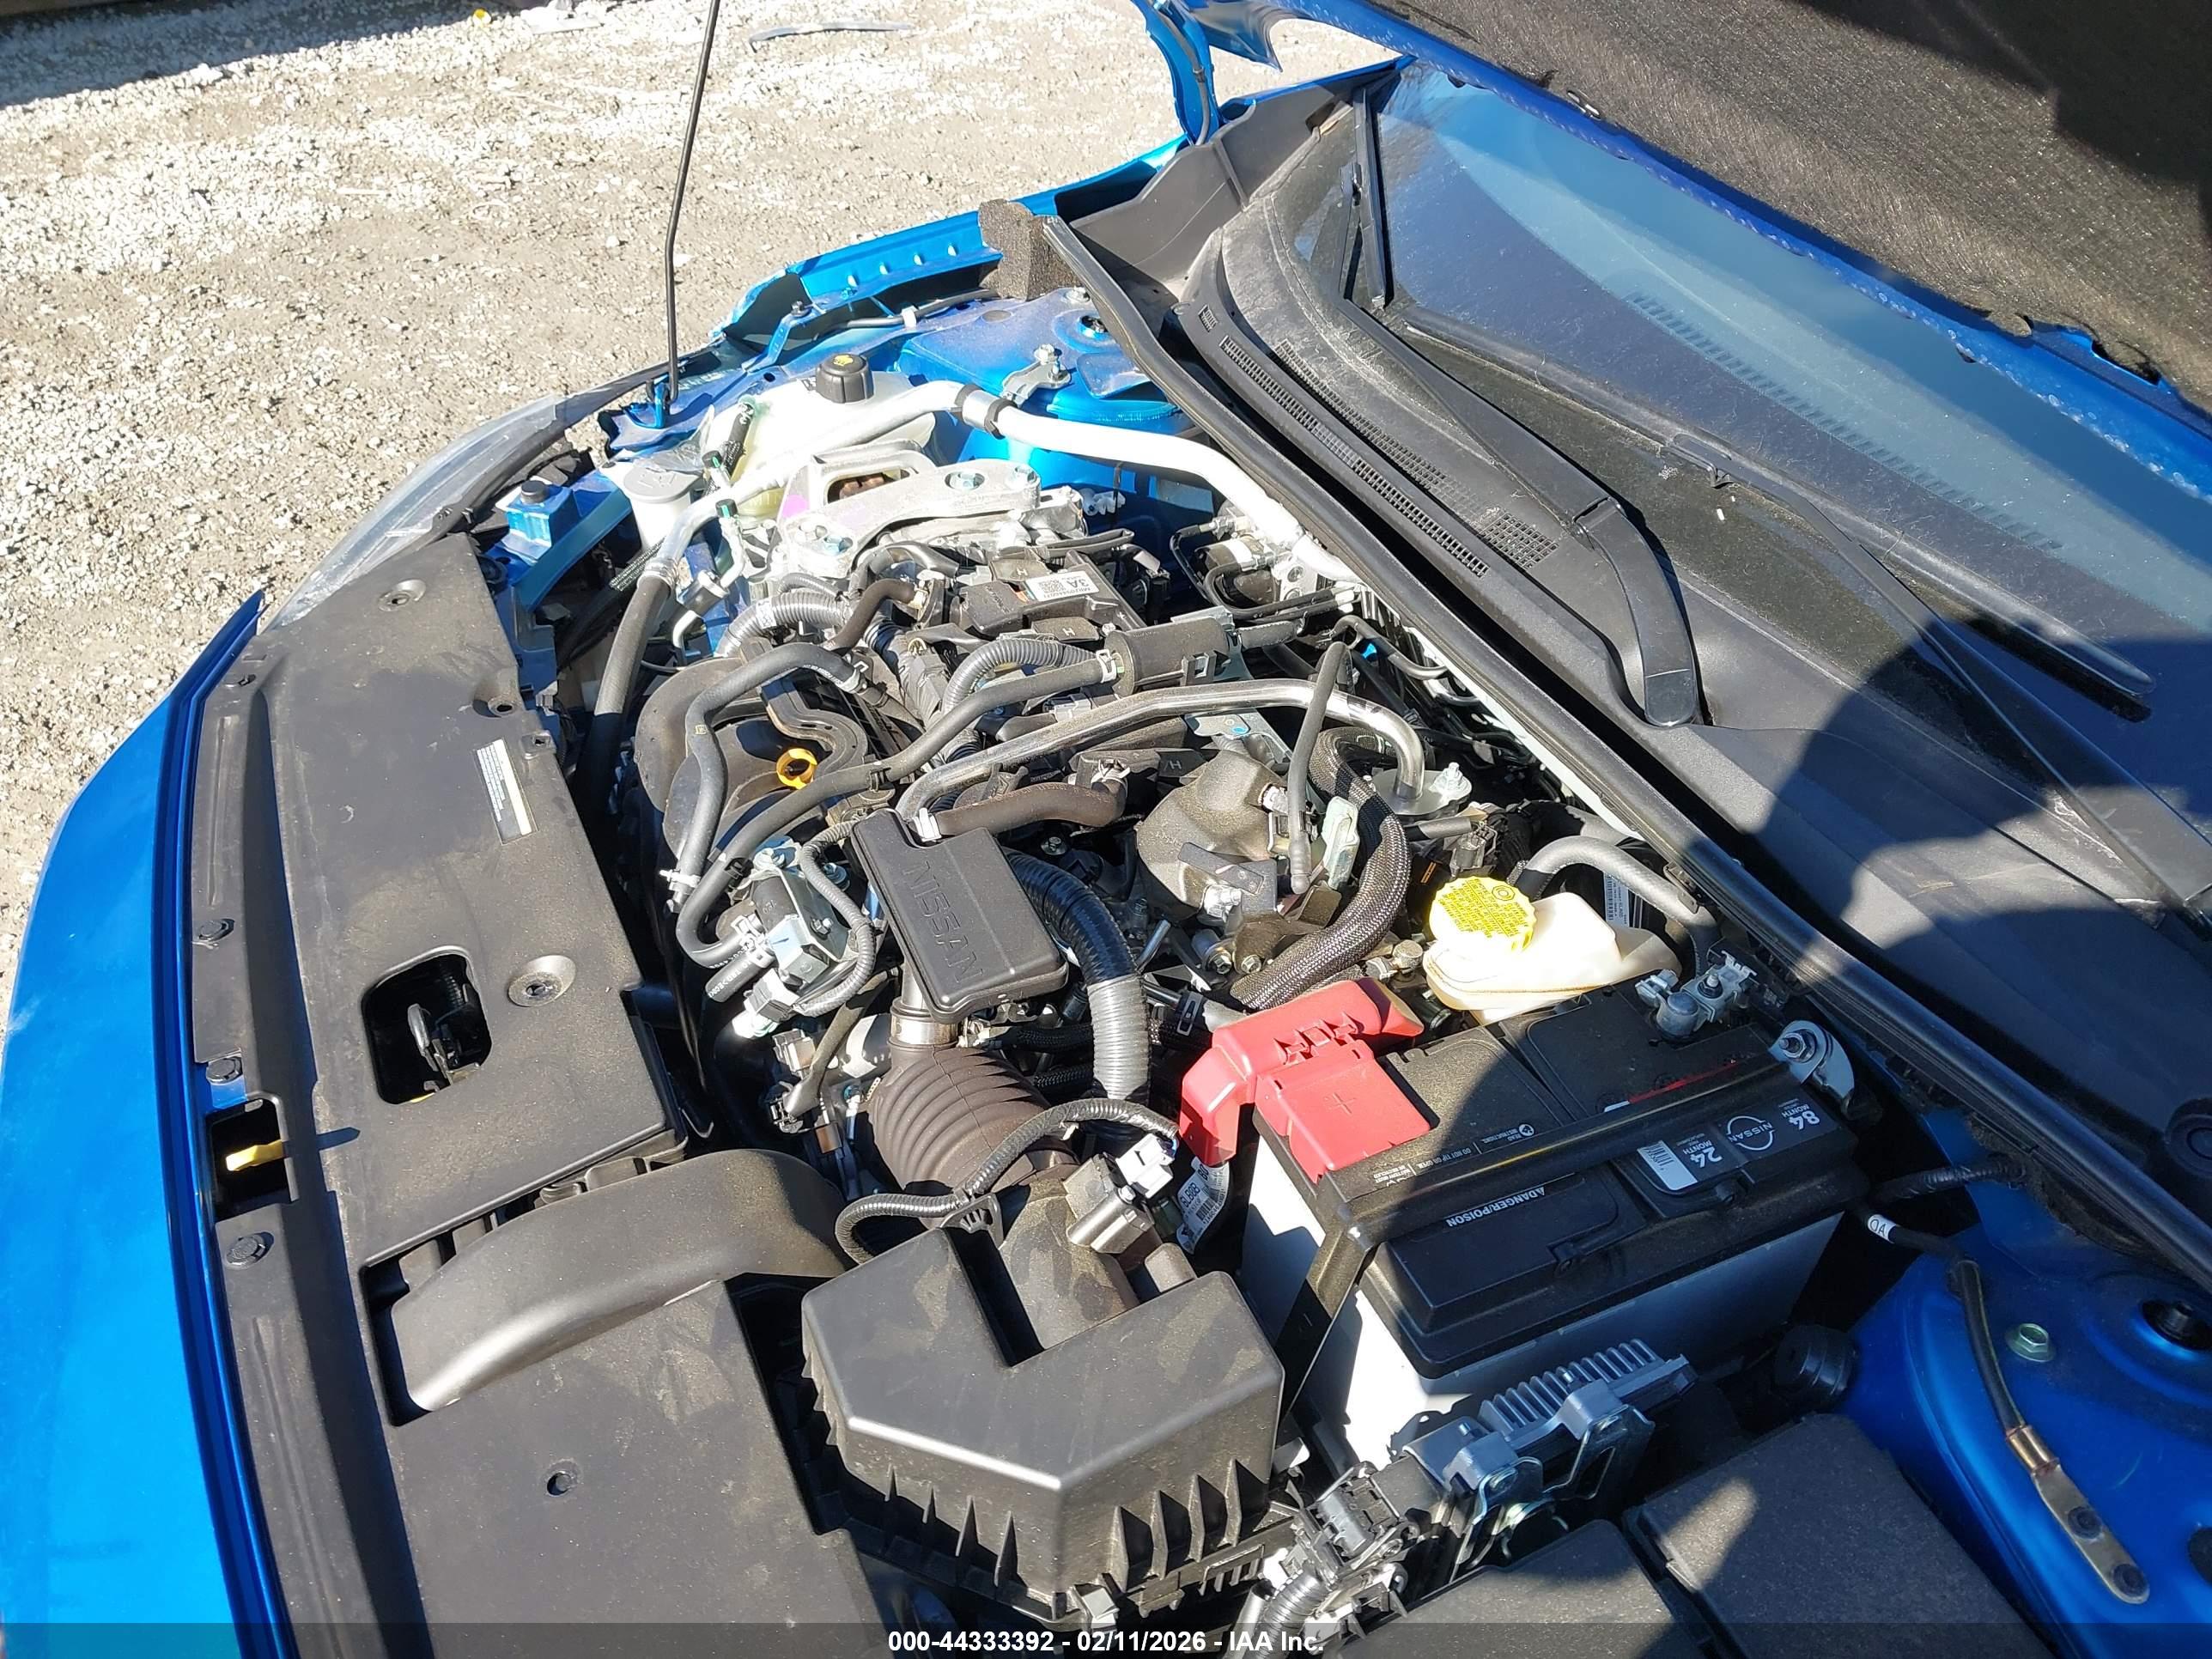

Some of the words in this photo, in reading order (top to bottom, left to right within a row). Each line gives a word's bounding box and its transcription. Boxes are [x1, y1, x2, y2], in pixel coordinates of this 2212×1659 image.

[1069, 578, 1091, 588] 3A
[902, 860, 983, 983] NISSAN
[1782, 1103, 1810, 1118] MONTH
[1789, 1110, 1820, 1130] 84
[1728, 1122, 1772, 1142] NISSAN
[1683, 1139, 1712, 1155] MONTH
[1690, 1146, 1723, 1168] 24
[1446, 1189, 1539, 1227] DANGER/POISON
